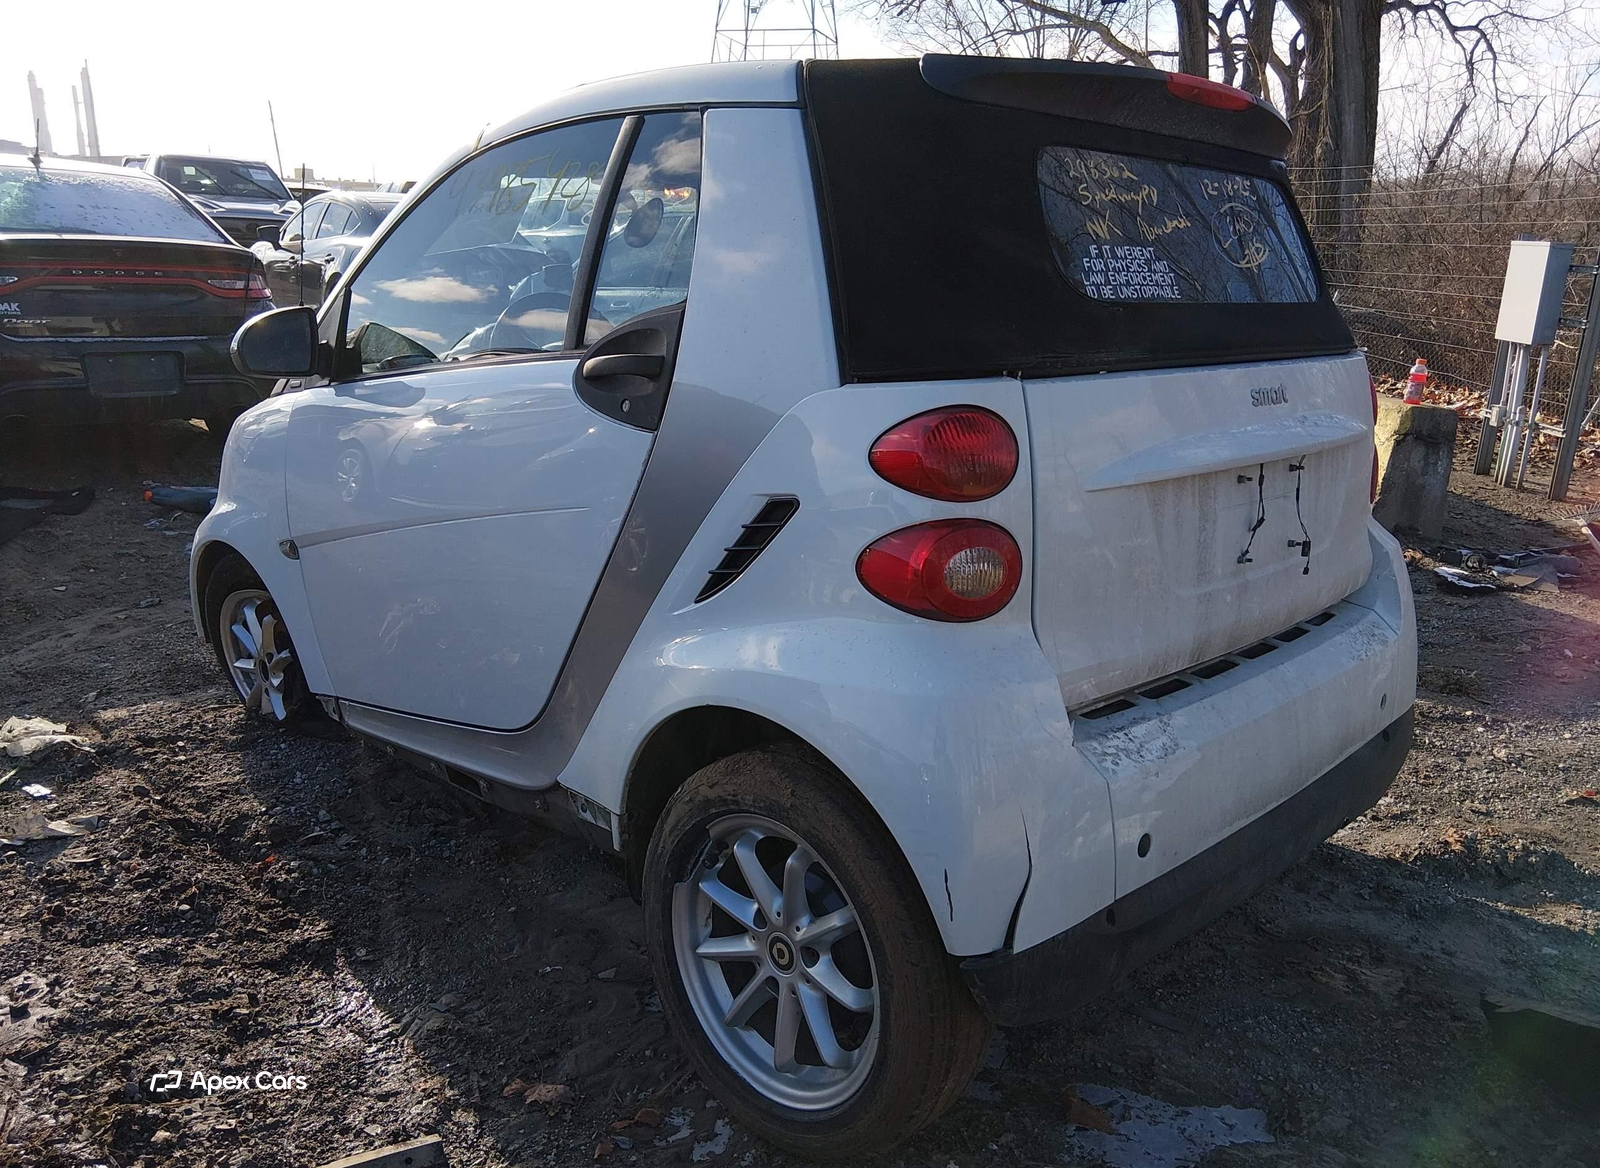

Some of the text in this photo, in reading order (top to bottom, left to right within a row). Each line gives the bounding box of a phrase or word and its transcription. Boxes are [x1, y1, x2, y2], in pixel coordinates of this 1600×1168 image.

[1089, 245, 1099, 258] IF
[1102, 245, 1112, 258] IT
[1083, 258, 1169, 273] FOR PHYSICS AND
[72, 269, 163, 277] DODGE
[1082, 271, 1176, 286] LAW ENFORCEMENT
[1100, 286, 1116, 299] BE
[1117, 286, 1182, 299] UNSTOPPABLE
[1250, 383, 1288, 408] smart
